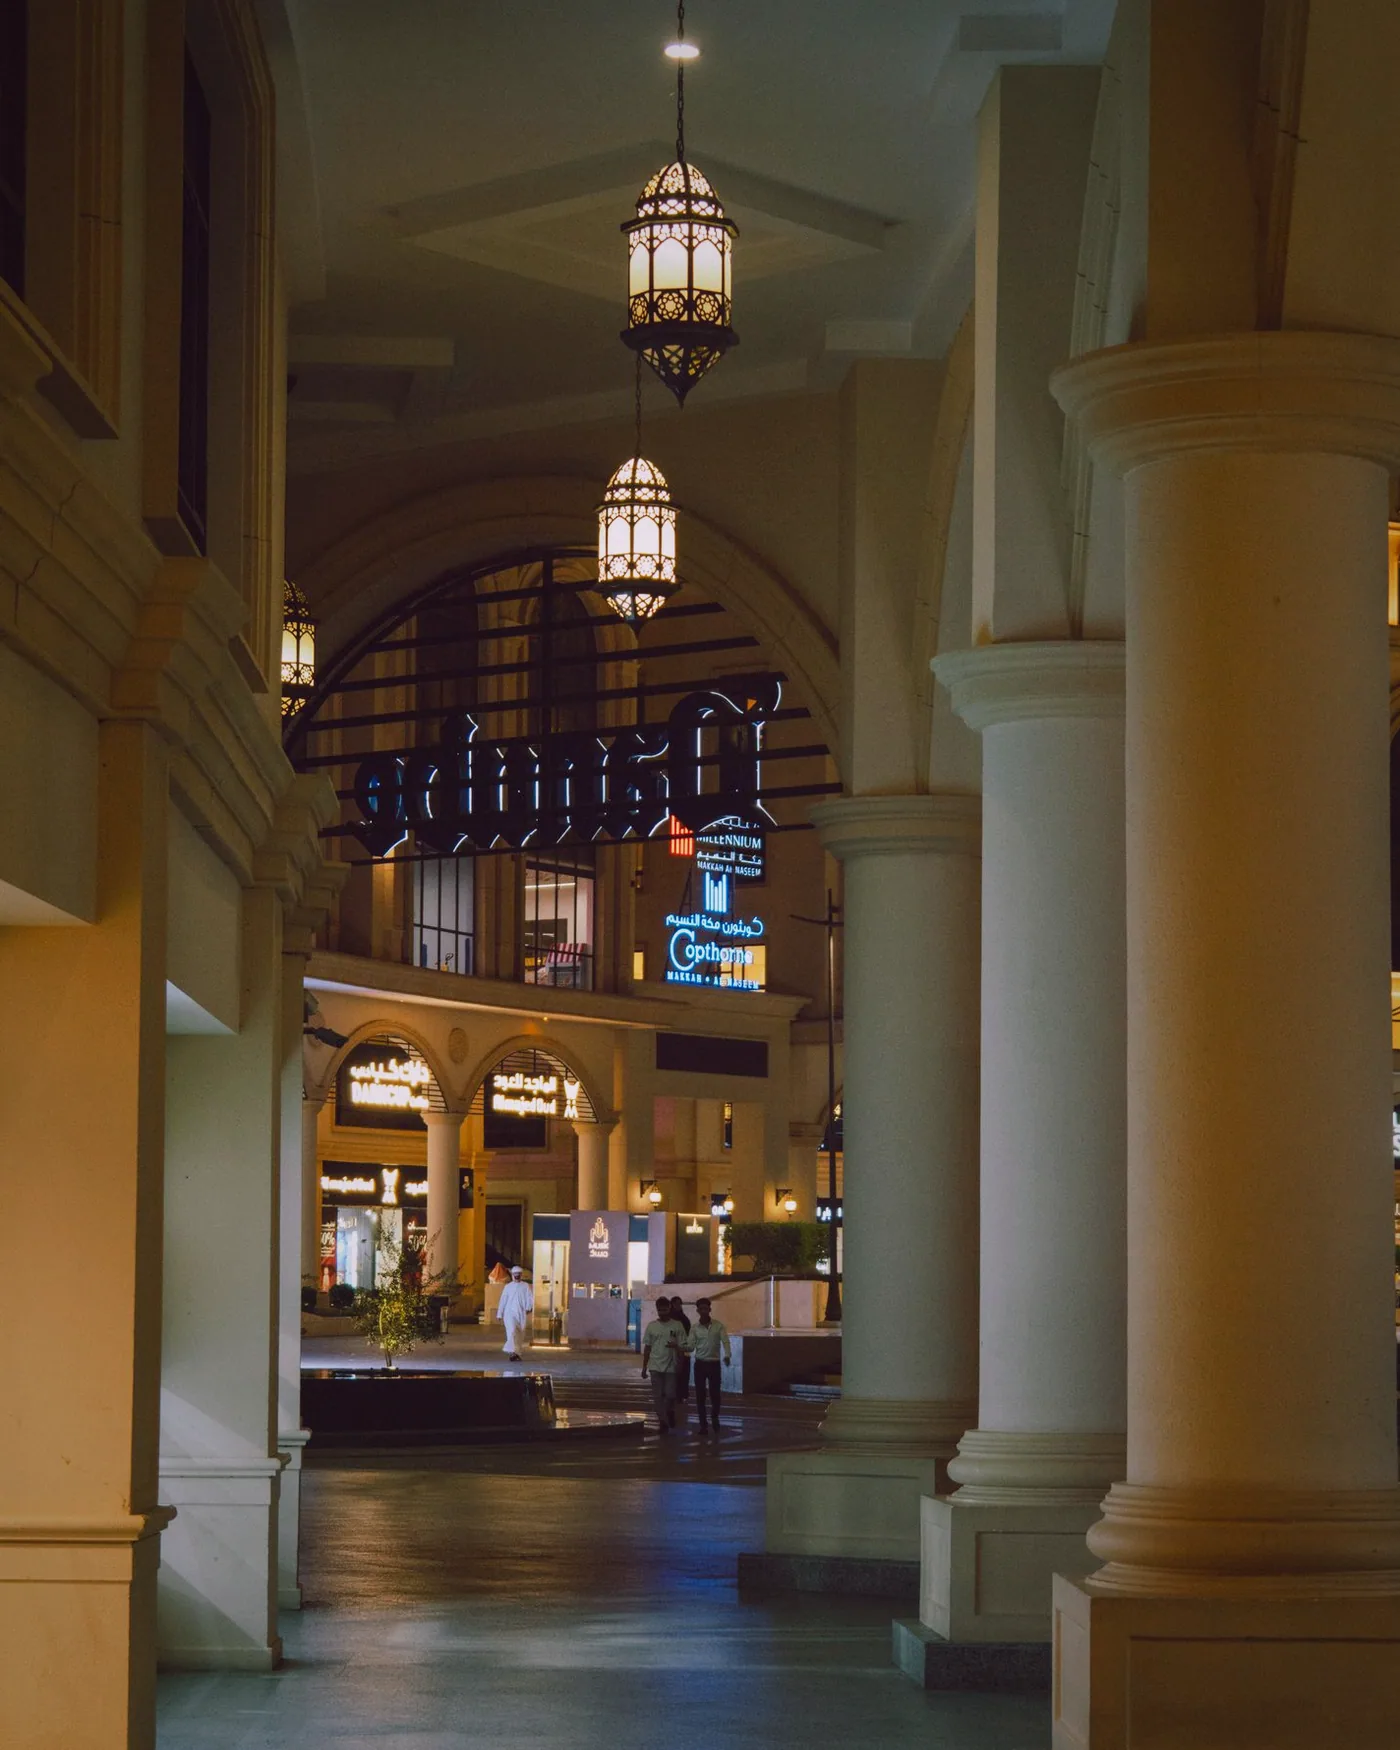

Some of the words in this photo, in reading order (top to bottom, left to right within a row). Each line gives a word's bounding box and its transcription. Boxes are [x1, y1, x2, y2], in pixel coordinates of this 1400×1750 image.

[697, 860, 724, 872] MAKKAH
[735, 865, 761, 877] NASEEM
[665, 913, 700, 926] النسيم
[701, 914, 720, 930] مكة
[669, 928, 754, 972] Copthorne
[667, 971, 702, 983] MAKKAH
[320, 1231, 336, 1248] 0%
